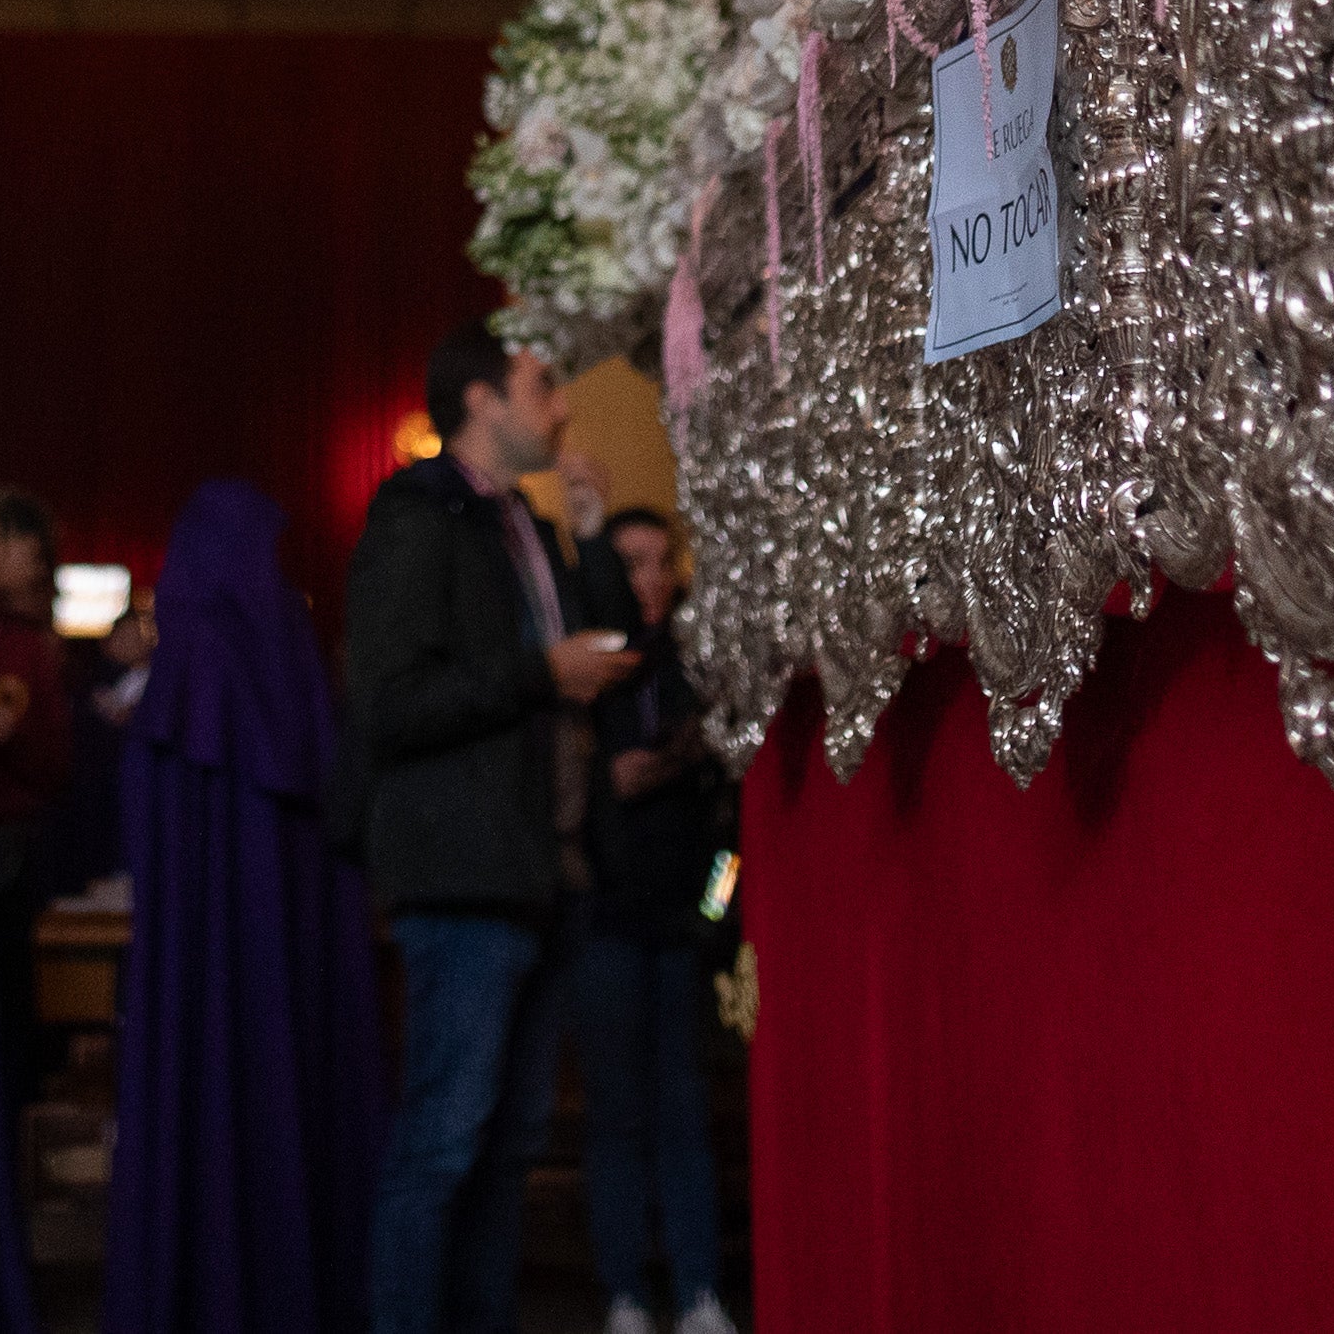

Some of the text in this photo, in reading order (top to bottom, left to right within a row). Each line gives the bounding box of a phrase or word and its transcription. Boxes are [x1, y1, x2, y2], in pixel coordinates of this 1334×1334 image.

[1003, 105, 1034, 154] RUEGA
[950, 168, 1052, 273] NO TOCAR
